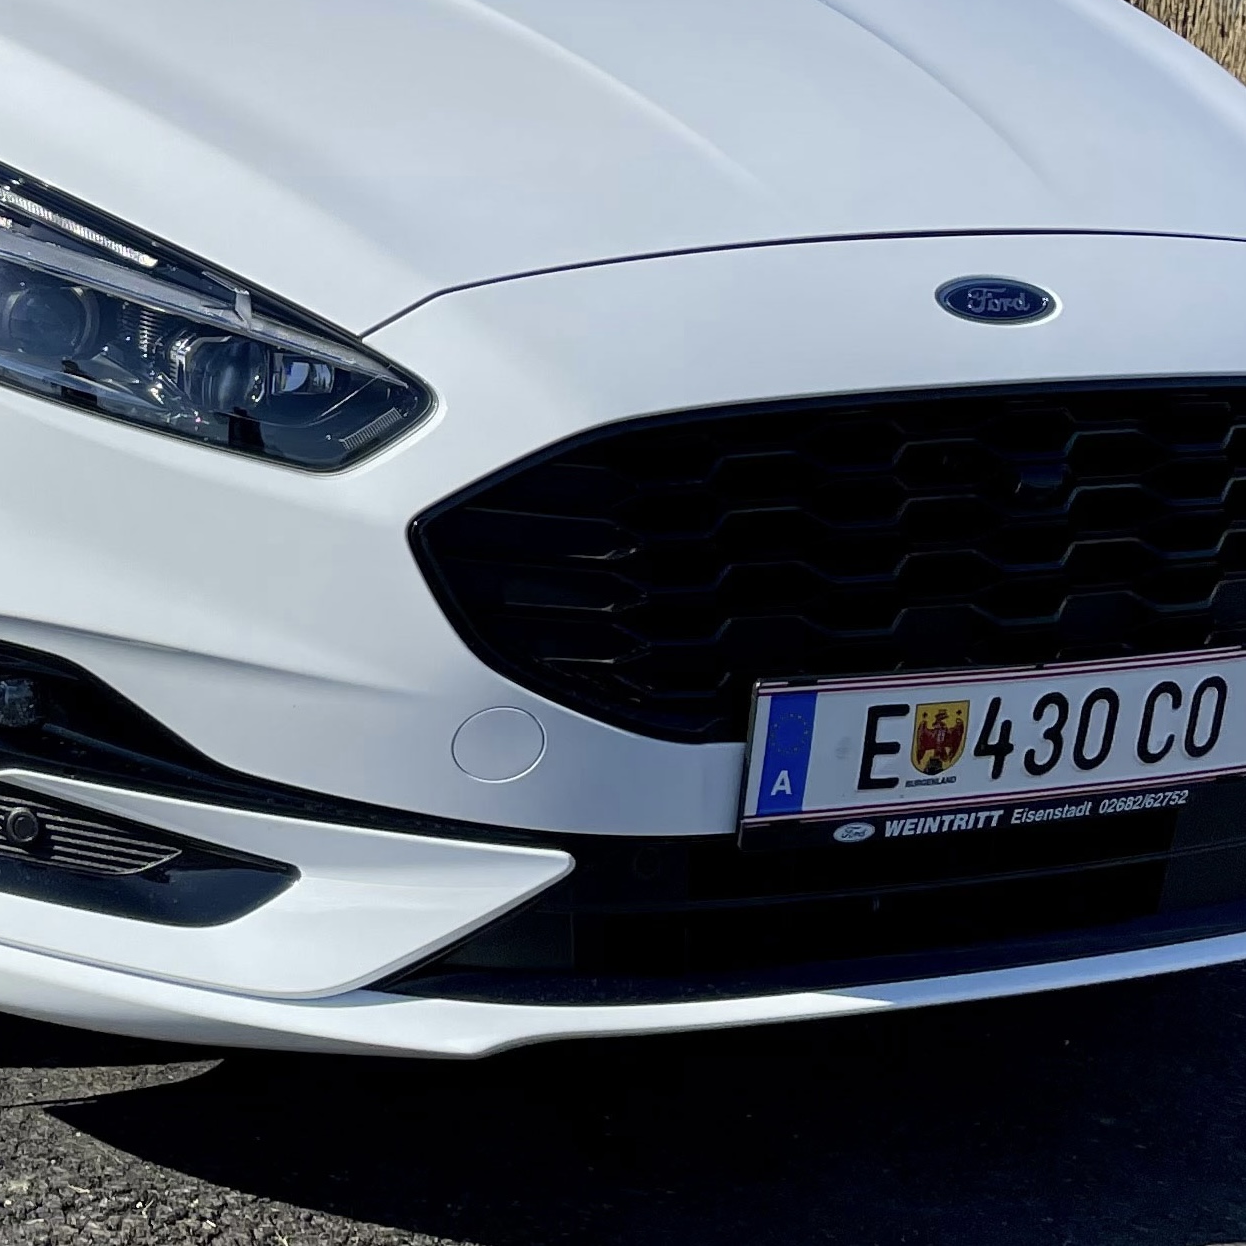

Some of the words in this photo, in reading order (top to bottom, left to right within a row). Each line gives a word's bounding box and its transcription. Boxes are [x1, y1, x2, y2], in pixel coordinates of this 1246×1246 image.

[967, 287, 1030, 313] Ford
[857, 703, 910, 791] E
[973, 687, 1120, 780] 430
[770, 769, 793, 796] A
[885, 810, 1004, 837] WEINTRITT
[1011, 801, 1092, 824] Eisenstadt
[1098, 790, 1189, 814] 02682/62752
